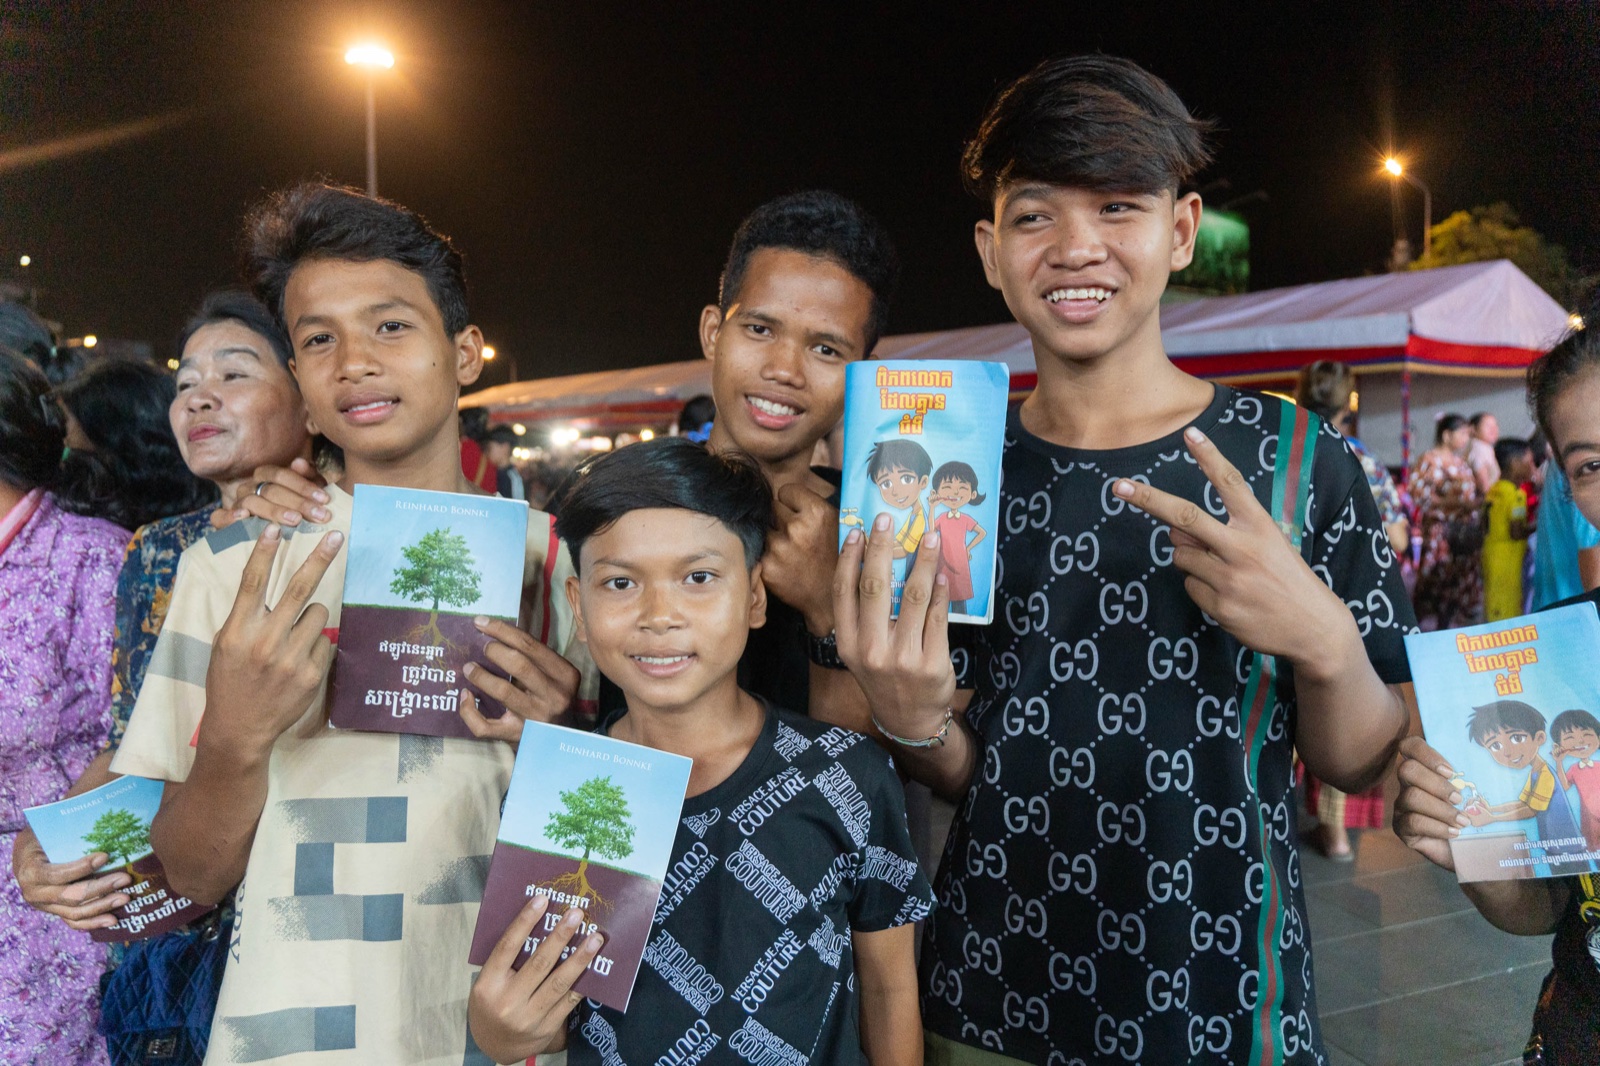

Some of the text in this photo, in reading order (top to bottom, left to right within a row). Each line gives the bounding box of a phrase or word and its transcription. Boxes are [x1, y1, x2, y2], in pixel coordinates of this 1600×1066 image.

[876, 365, 953, 388] ពិភពលោក
[395, 500, 448, 513] REINHARD
[1456, 624, 1539, 653] ពិភពលោក
[560, 742, 652, 771] REINHARD BONNKE
[60, 797, 103, 816] REINHARD
[728, 766, 798, 823] VERSACE JEANS
[738, 771, 810, 836] COUTURE
[681, 854, 719, 895] VERSACE
[725, 851, 799, 925] COUTURE
[739, 838, 808, 909] VERSACE JEANS
[650, 929, 724, 1004] COUTURE
[731, 928, 795, 1001] VERSACE JEANS
[741, 935, 806, 1013] COUTURE
